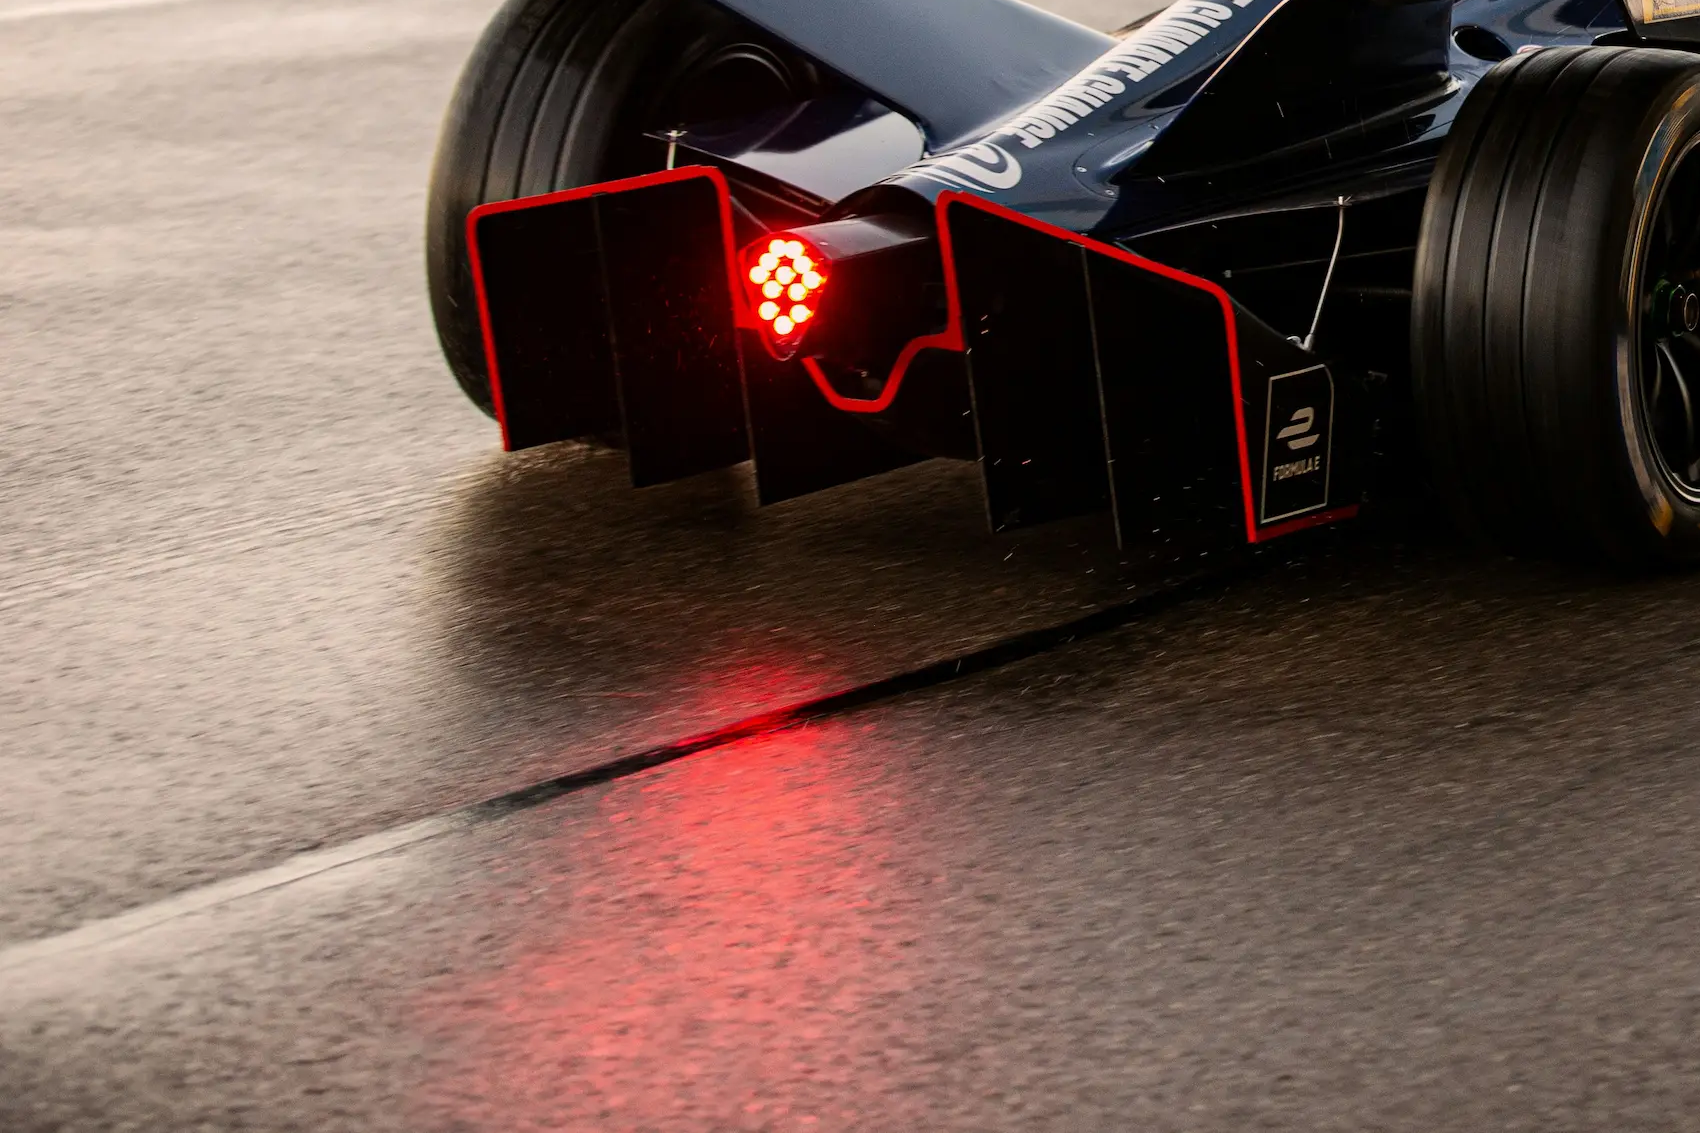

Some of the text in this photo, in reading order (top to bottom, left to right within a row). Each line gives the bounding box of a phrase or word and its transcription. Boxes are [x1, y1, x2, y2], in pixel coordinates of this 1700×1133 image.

[1000, 71, 1127, 149] CHANGE
[1272, 454, 1321, 482] FORMULA E
